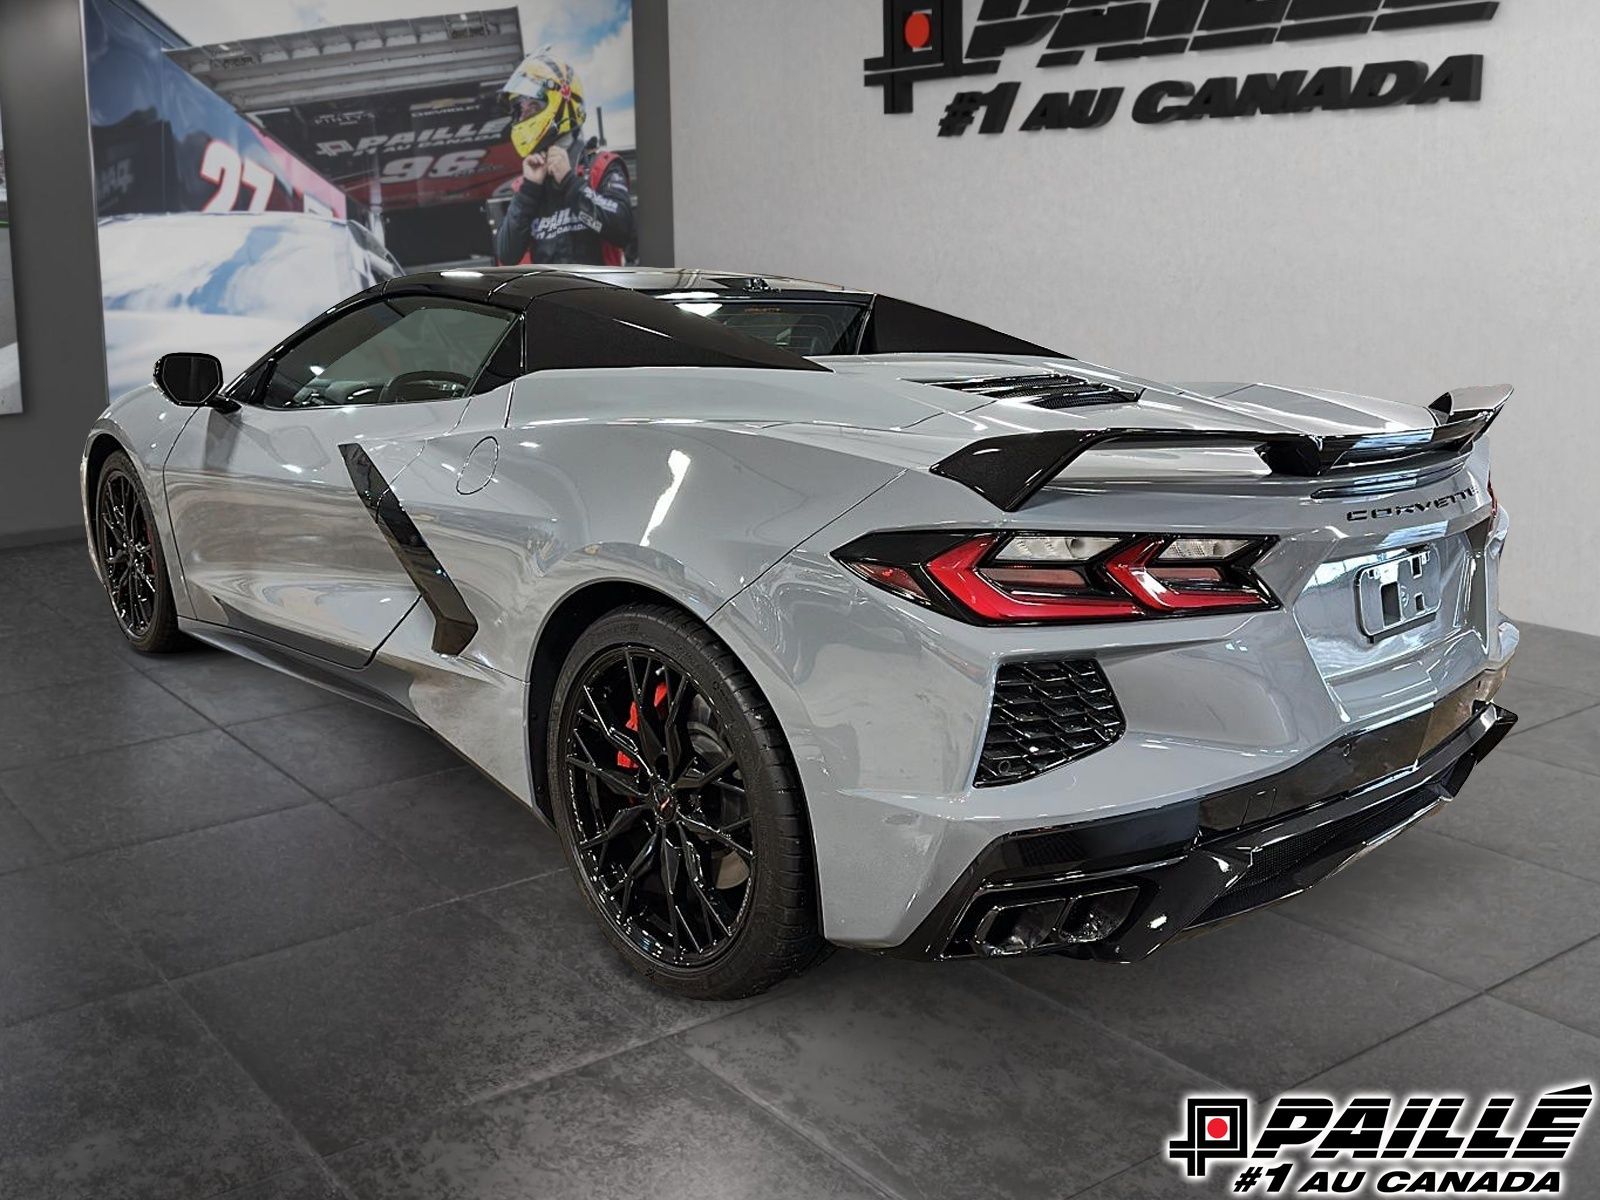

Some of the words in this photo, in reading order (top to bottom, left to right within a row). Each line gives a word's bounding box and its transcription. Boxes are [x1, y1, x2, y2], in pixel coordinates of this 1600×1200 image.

[938, 82, 1021, 137] #1
[1019, 87, 1125, 131] AU
[1131, 54, 1484, 124] CANADA
[200, 140, 276, 211] 27
[379, 149, 487, 183] 96
[1346, 486, 1480, 522] CORVETTE
